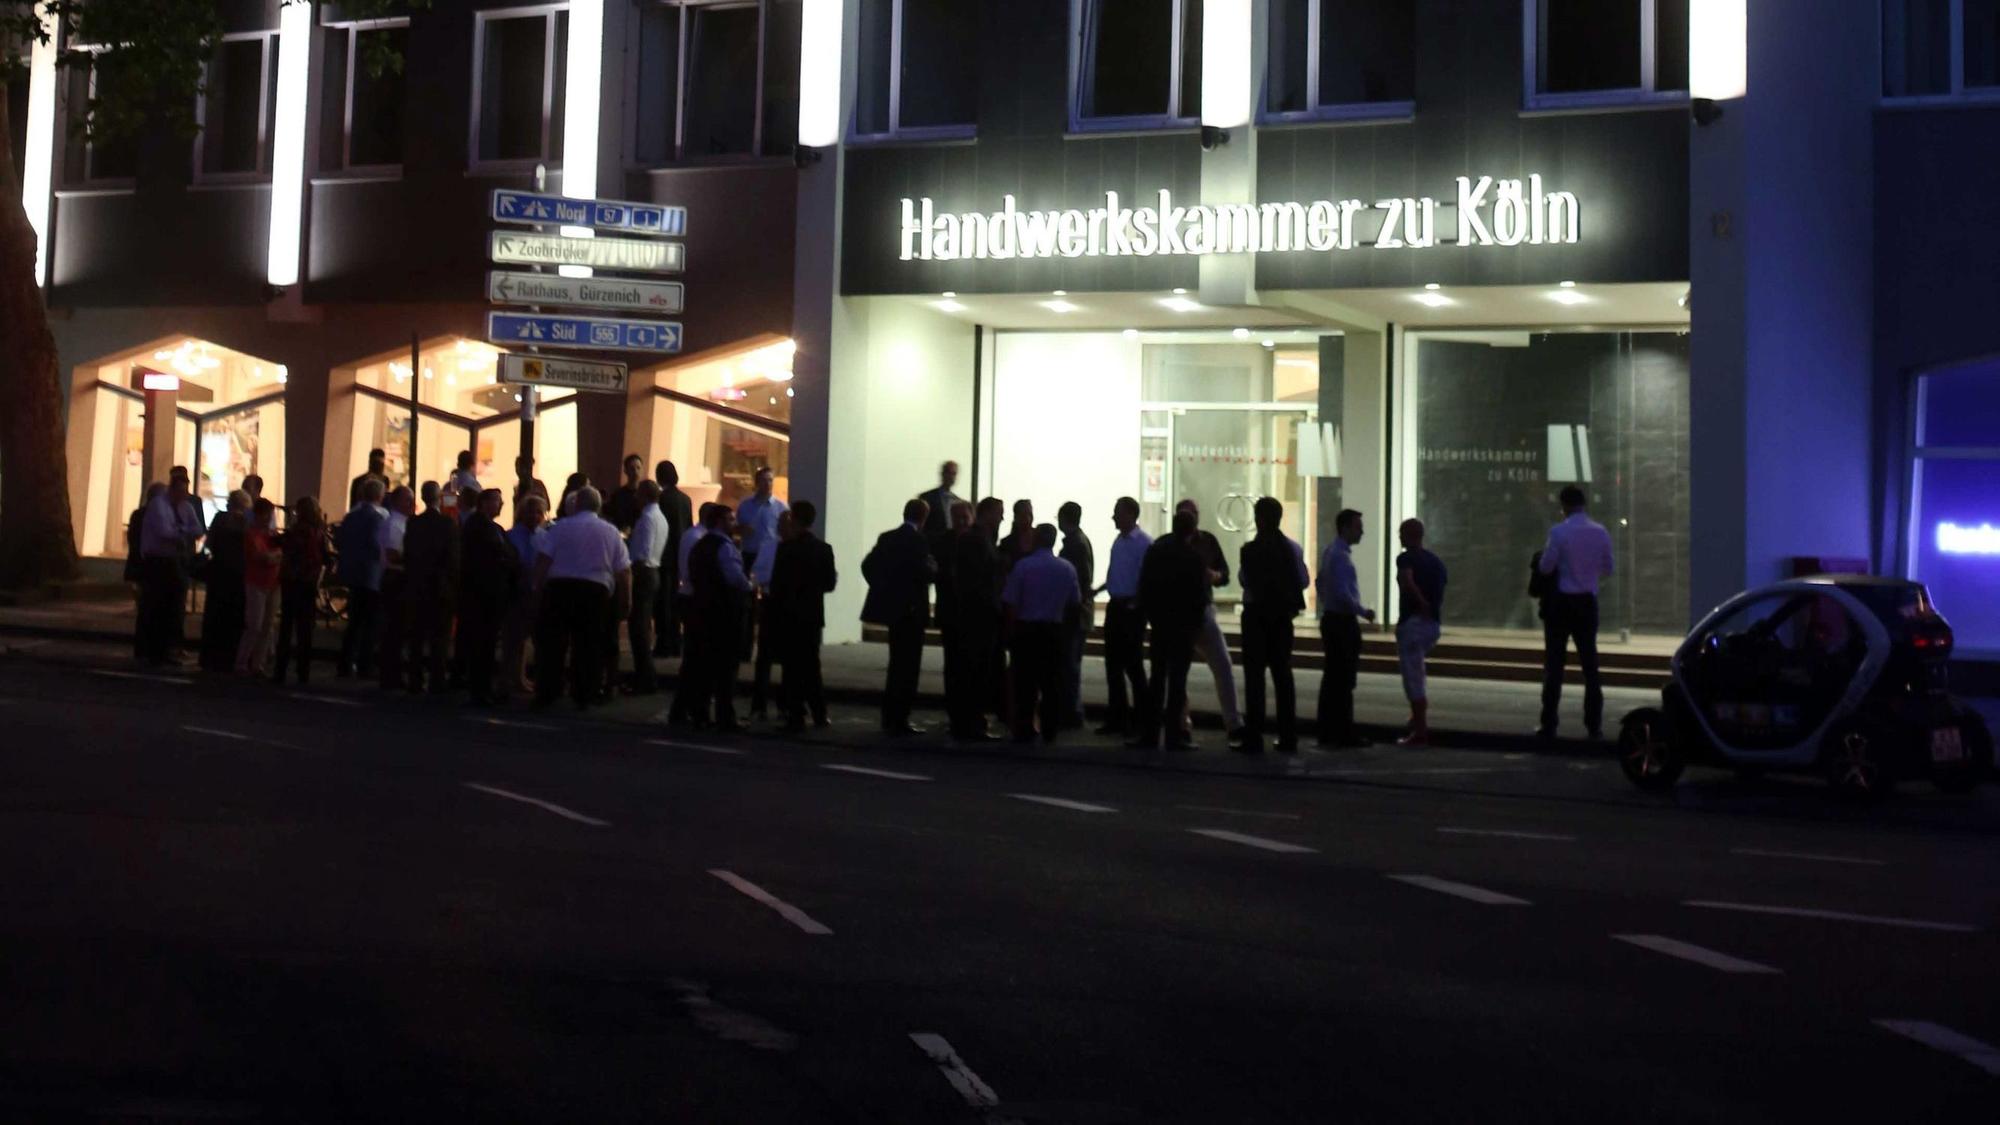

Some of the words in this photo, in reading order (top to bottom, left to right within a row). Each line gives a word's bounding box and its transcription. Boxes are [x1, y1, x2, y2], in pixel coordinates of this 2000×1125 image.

[555, 203, 586, 222] Nord
[604, 210, 616, 223] 57
[899, 190, 1361, 261] Handwerkskammer
[1375, 197, 1434, 248] zu
[1456, 173, 1580, 247] Köln
[516, 281, 574, 301] Rathaus,
[579, 284, 641, 303] Gürzenich
[551, 325, 576, 340] Süd
[595, 330, 615, 344] 555
[1418, 446, 1537, 462] Handwerkskammer
[1508, 468, 1538, 482] Köln
